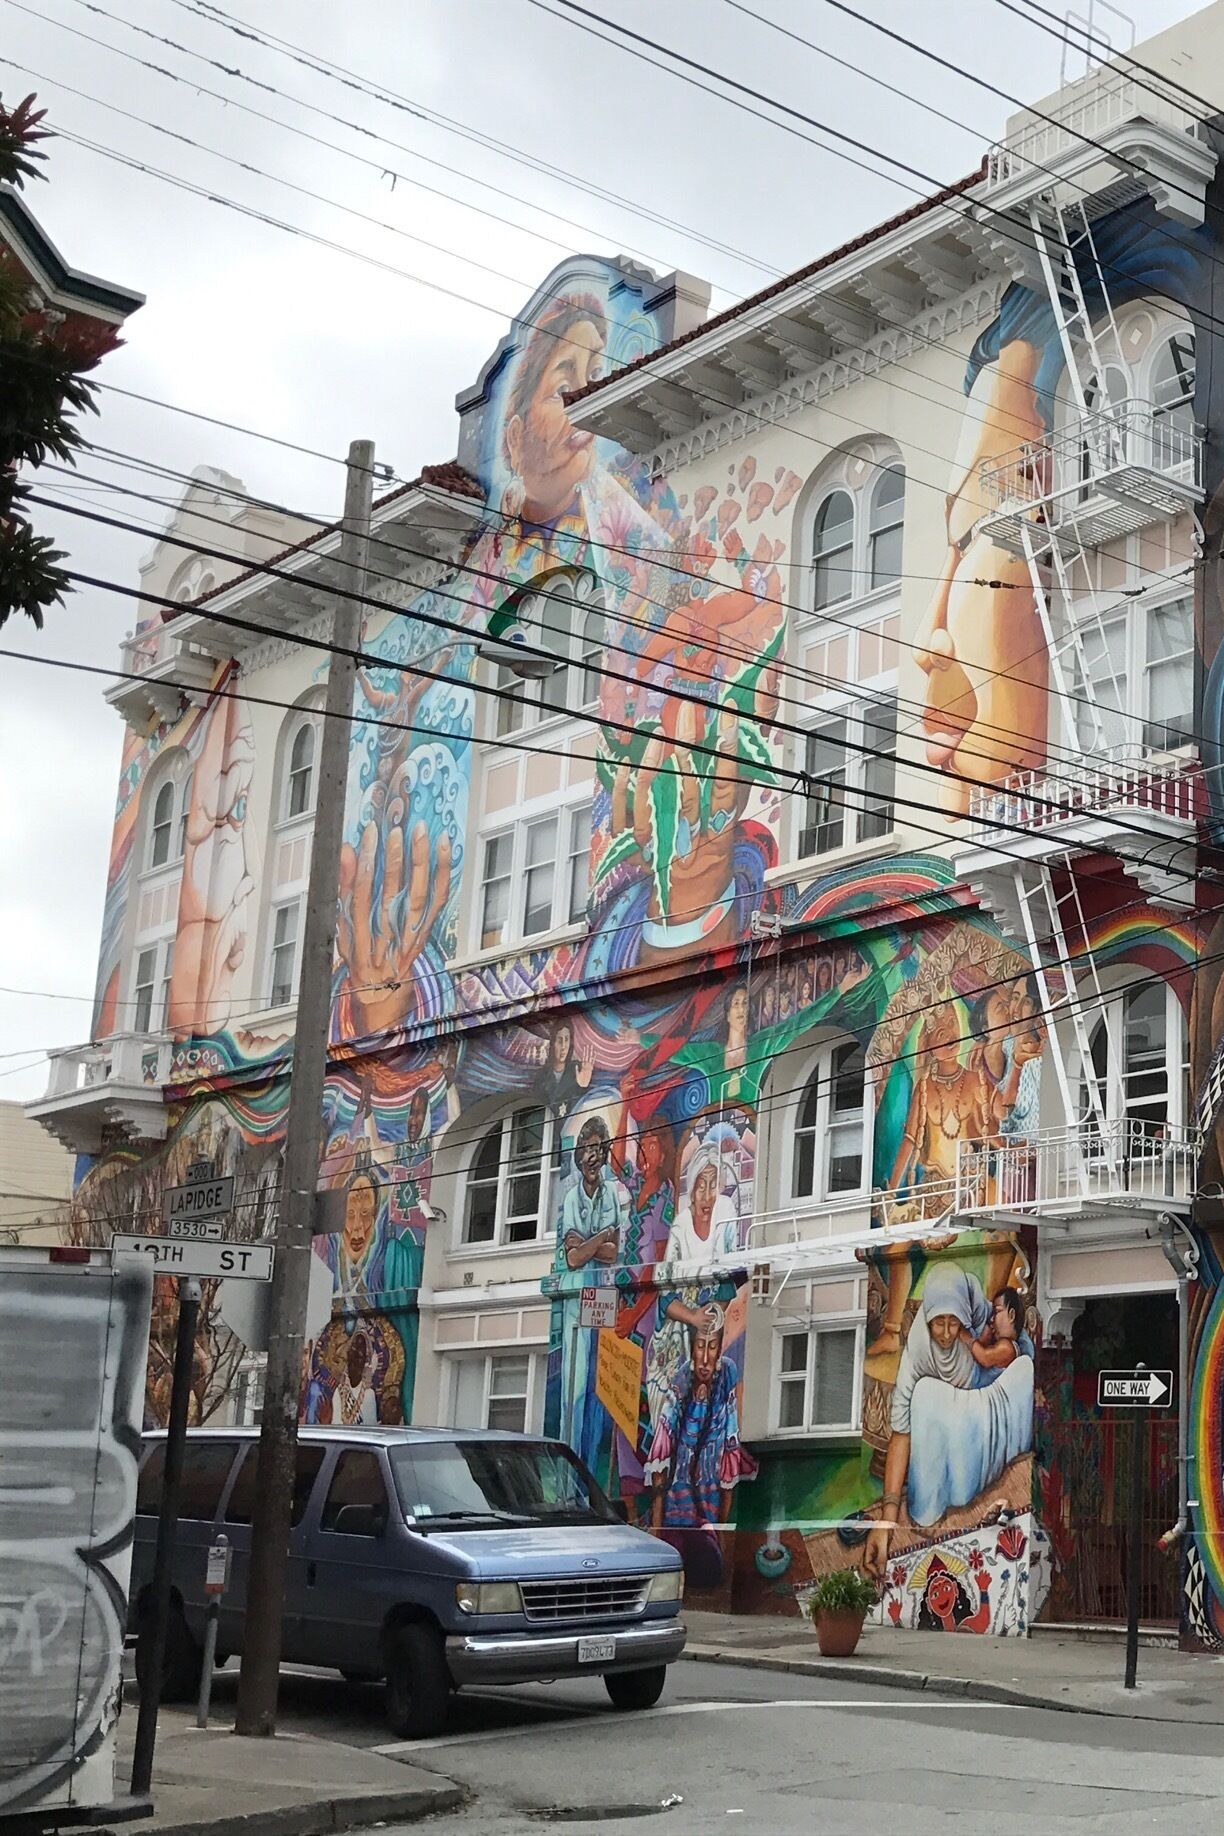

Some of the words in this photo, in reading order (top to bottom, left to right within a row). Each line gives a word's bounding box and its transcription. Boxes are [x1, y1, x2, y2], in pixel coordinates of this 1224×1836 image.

[170, 1187, 223, 1214] LAPIDGE
[173, 1221, 207, 1237] 3530
[219, 1250, 252, 1271] ST
[583, 1288, 595, 1299] NO
[584, 1301, 614, 1311] PARKING
[591, 1318, 606, 1326] TIME
[1106, 1382, 1126, 1395] ONE
[1130, 1382, 1150, 1395] WAY
